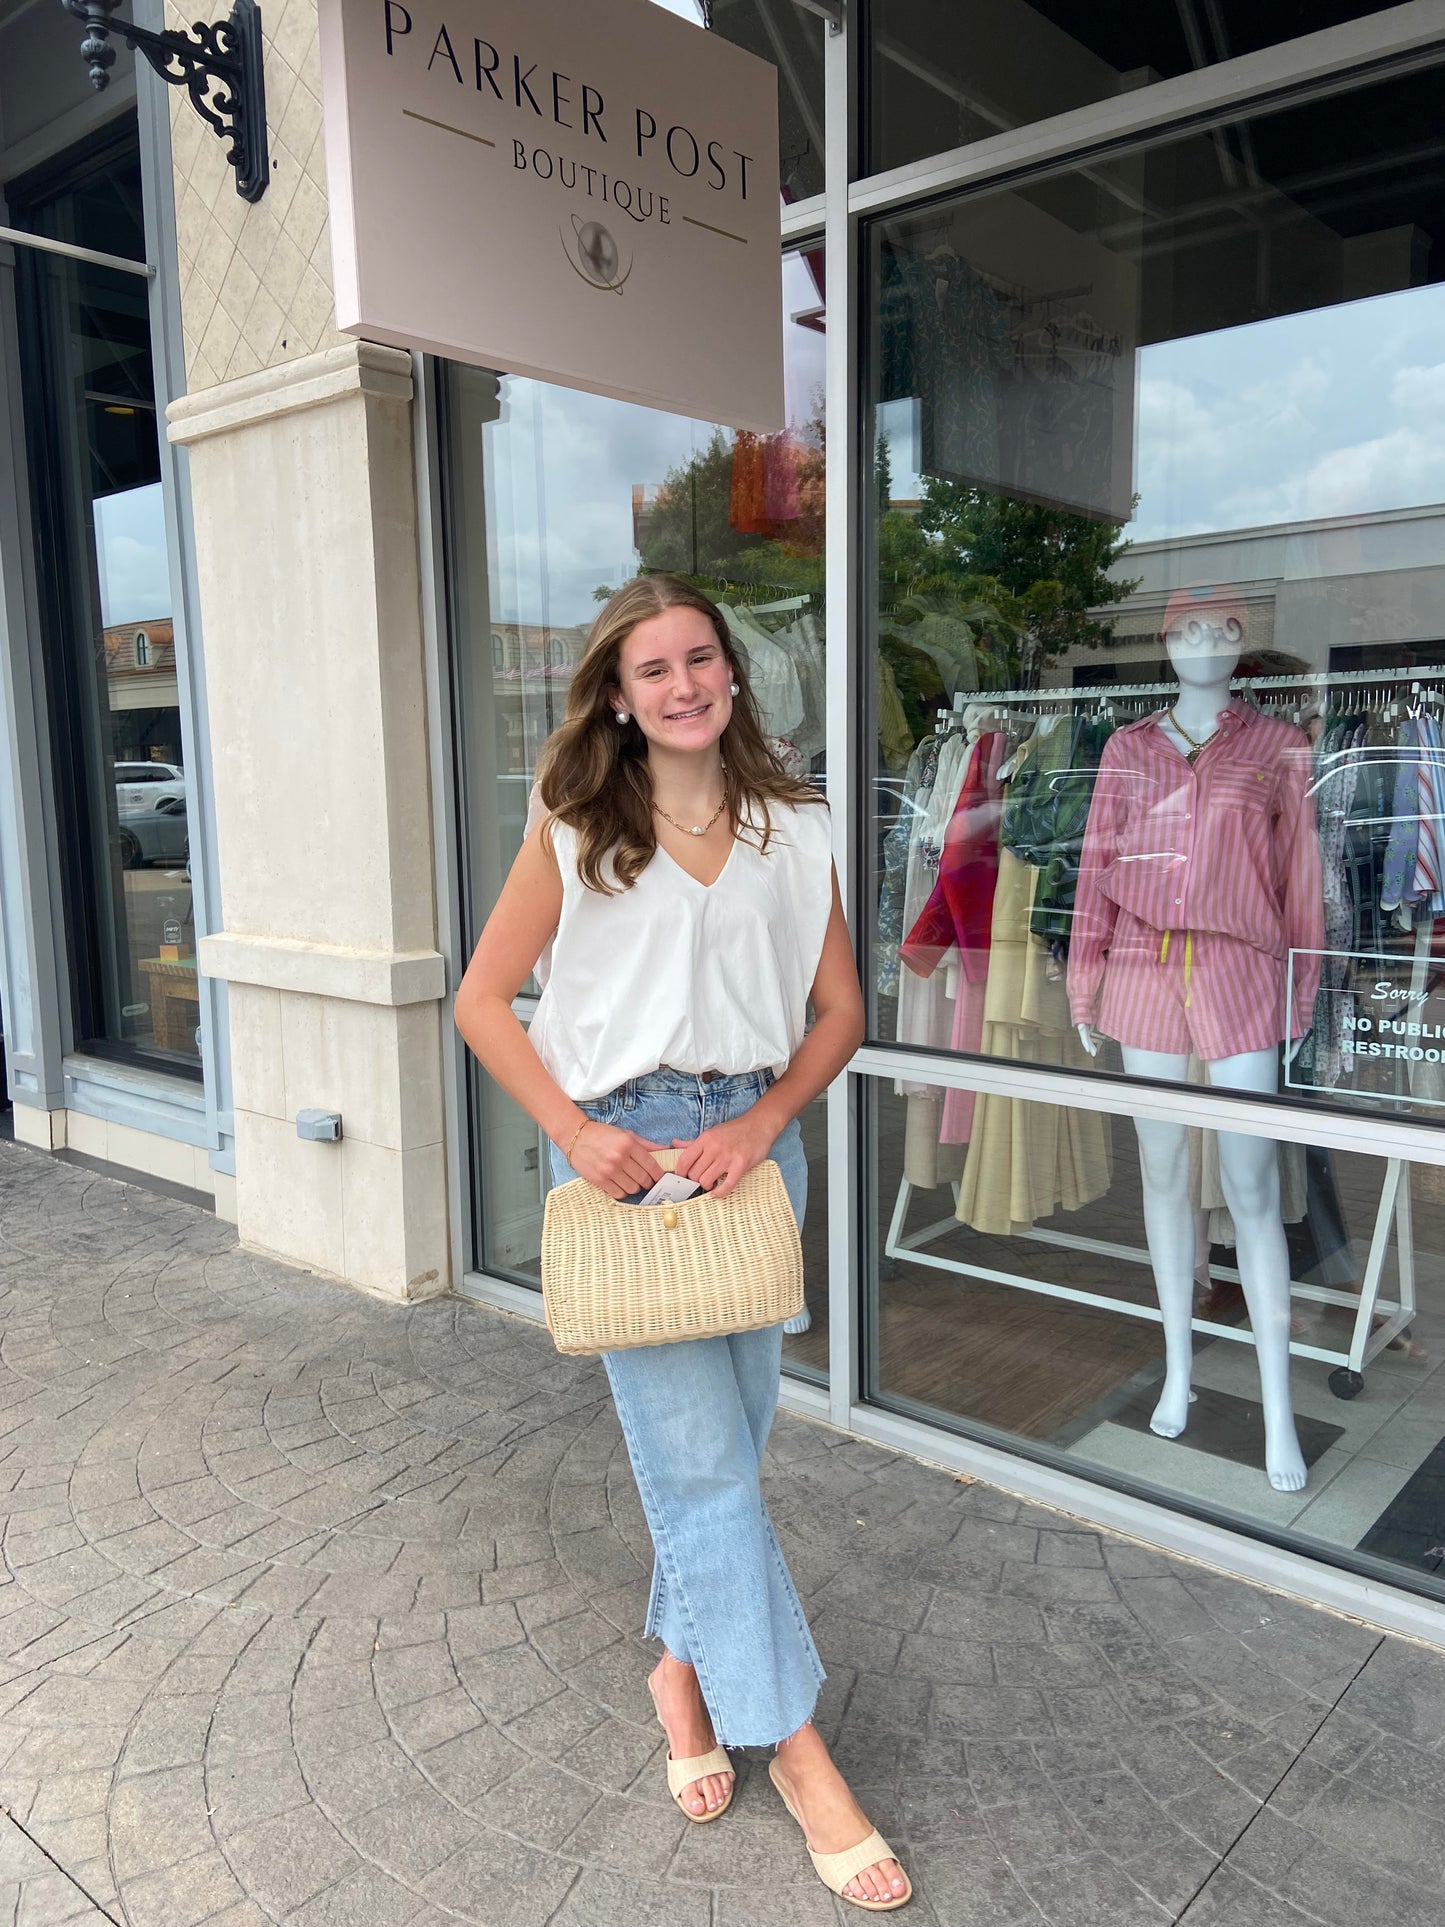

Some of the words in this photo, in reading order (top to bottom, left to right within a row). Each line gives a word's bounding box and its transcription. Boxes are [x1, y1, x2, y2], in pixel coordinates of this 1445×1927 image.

[384, 0, 607, 143] PARKER
[635, 108, 754, 200] POST
[512, 138, 672, 225] BOUTIQUE
[1370, 981, 1429, 1008] Sorry
[1342, 1016, 1372, 1032] NO
[1378, 1019, 1445, 1039] PUBLI
